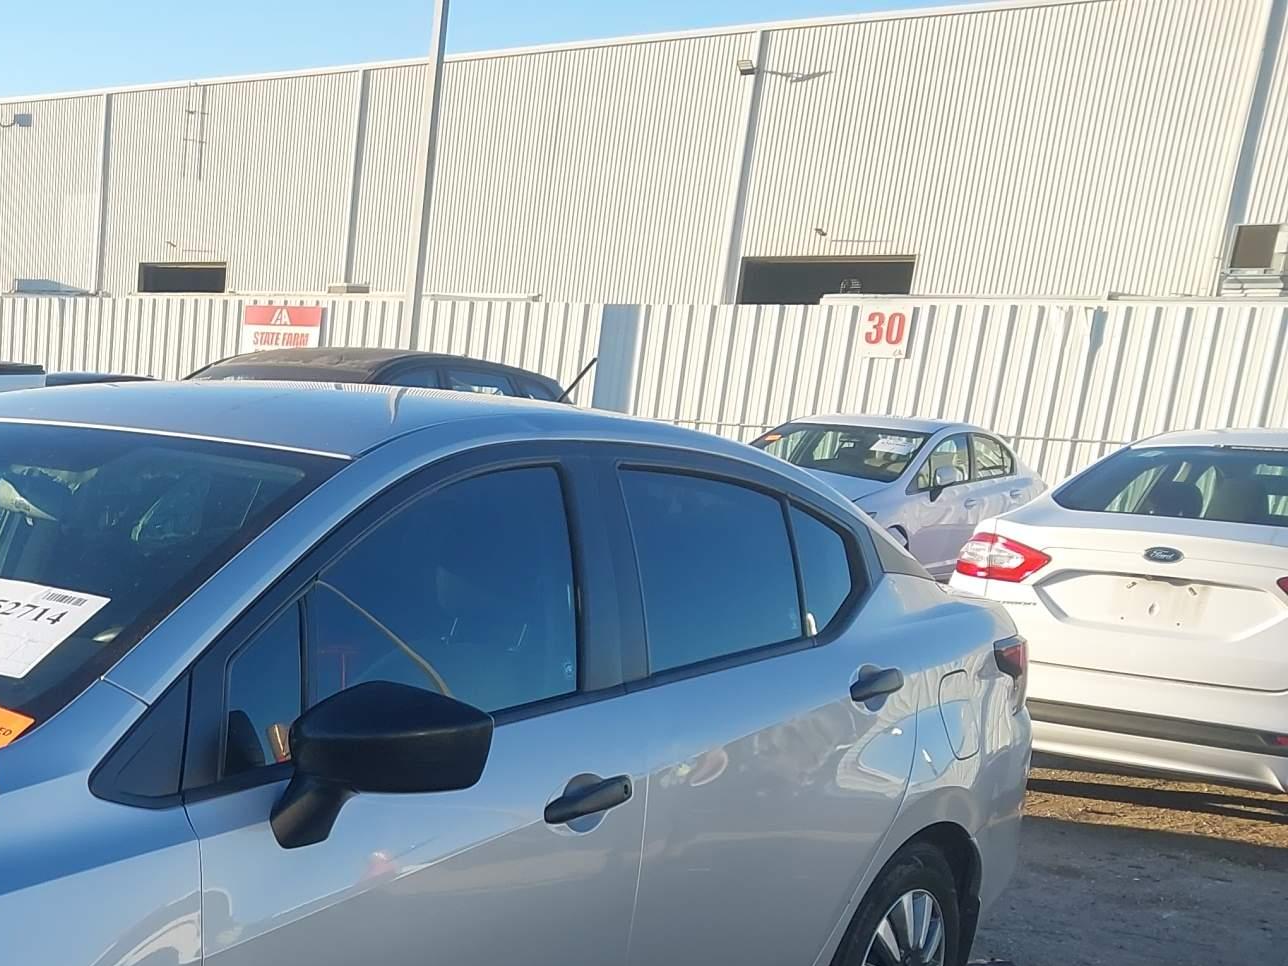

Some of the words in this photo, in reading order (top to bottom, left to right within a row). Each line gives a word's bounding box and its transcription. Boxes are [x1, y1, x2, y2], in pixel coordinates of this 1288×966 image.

[253, 331, 281, 346] STATE
[282, 332, 310, 347] FARM
[864, 311, 906, 345] 30
